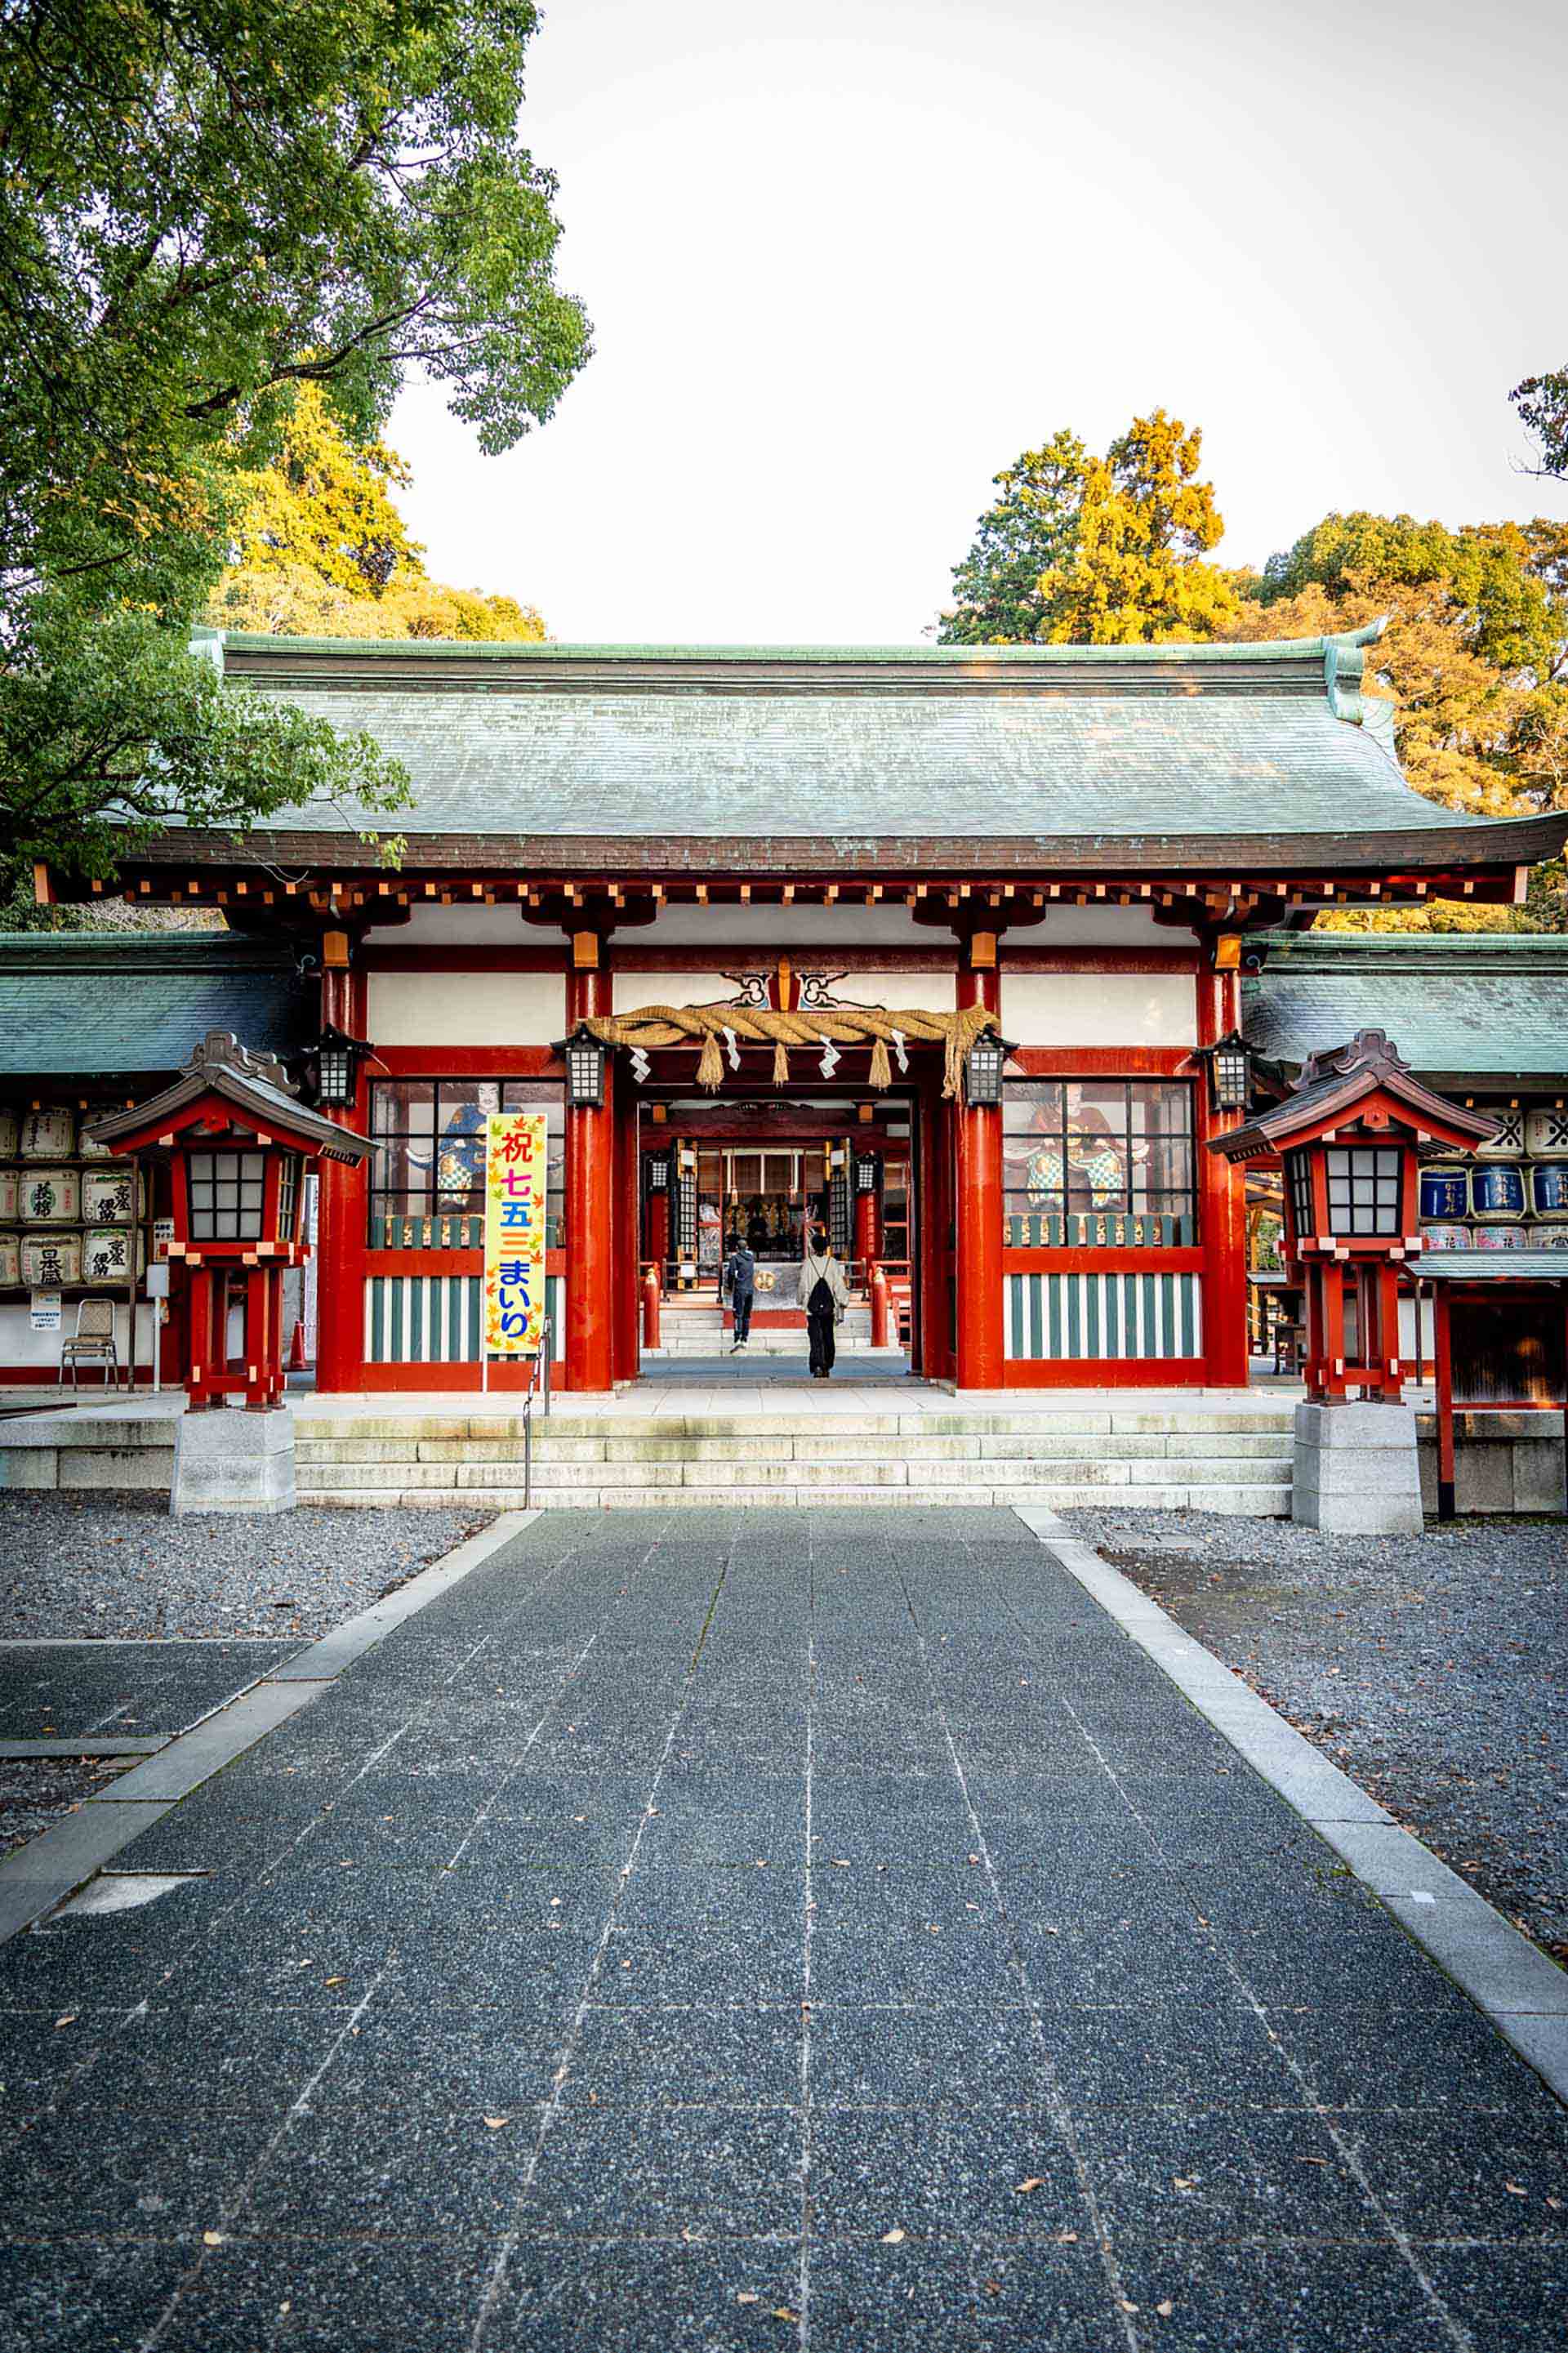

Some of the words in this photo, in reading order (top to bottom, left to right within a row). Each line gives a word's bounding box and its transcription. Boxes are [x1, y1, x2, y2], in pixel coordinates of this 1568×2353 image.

[498, 1132, 533, 1338] 祝七五三まいり
